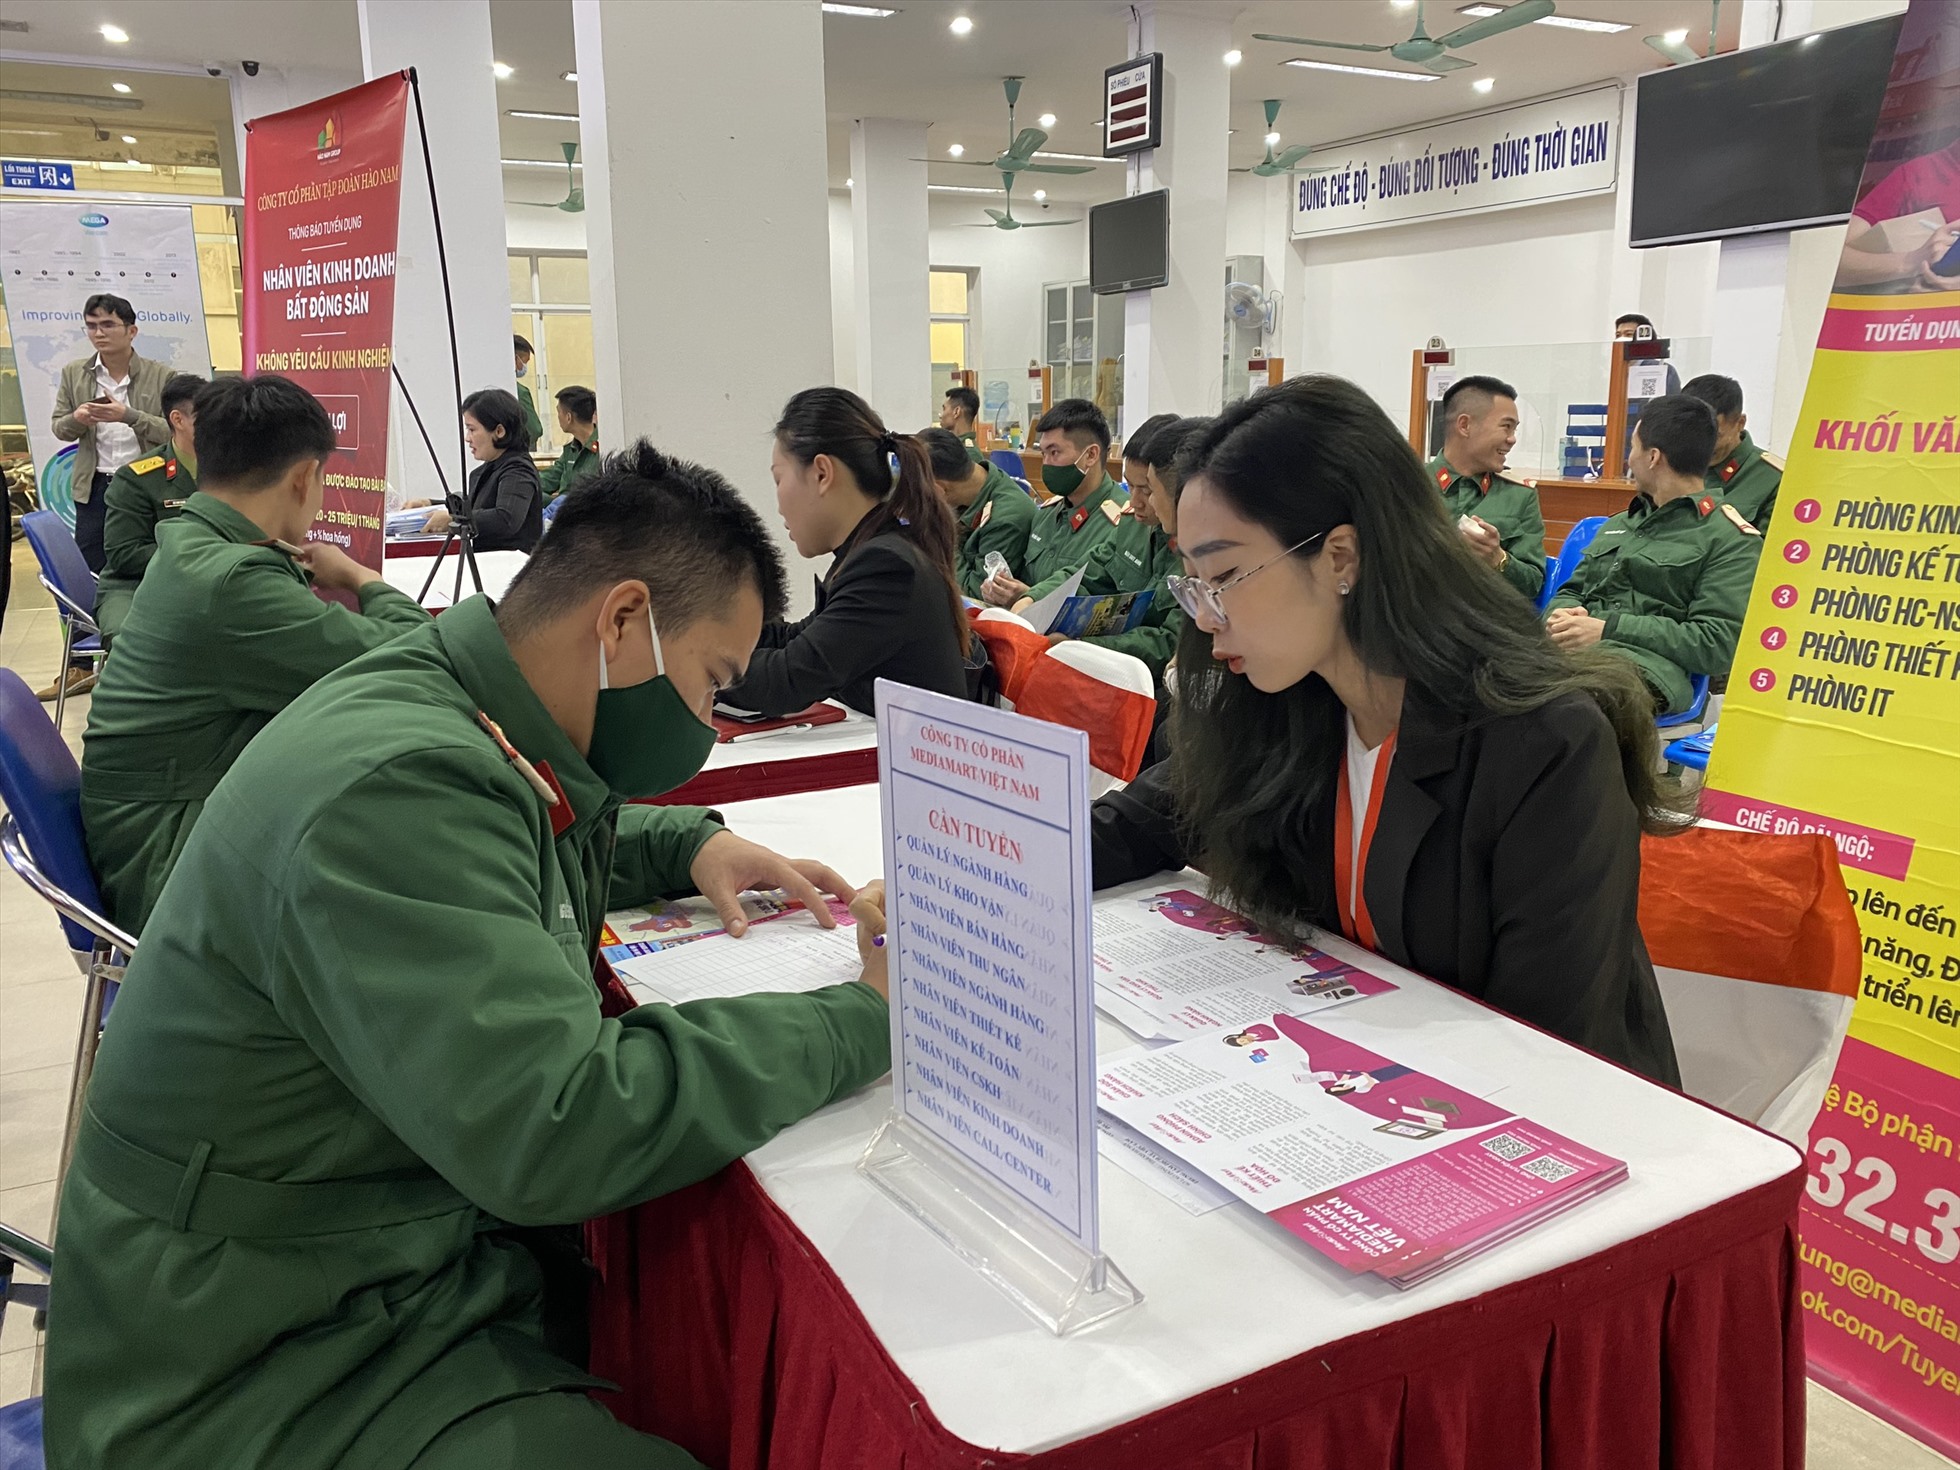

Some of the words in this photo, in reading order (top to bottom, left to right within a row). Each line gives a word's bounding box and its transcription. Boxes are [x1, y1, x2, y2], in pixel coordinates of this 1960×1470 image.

[258, 193, 277, 211] CÔNG
[277, 192, 288, 207] TY
[288, 184, 299, 205] CỔ
[300, 181, 321, 203] PHẦN
[322, 179, 337, 201] TẬP
[338, 173, 361, 195] ĐOÀN
[361, 168, 379, 189] HÀO
[380, 164, 399, 185] NAM
[1299, 173, 1327, 212] ĐÚNG
[1330, 160, 1353, 207] CHẾ
[1353, 161, 1368, 210] ĐỘ
[1379, 156, 1411, 199] ĐÚNG
[1414, 143, 1435, 193] ĐỐI
[1438, 145, 1479, 195] TƯỢNG
[1492, 132, 1530, 180] ĐÚNG
[1535, 121, 1567, 172] THỜI
[1571, 121, 1609, 166] GIAN
[82, 216, 106, 224] MEGA
[288, 226, 309, 240] THÔNG
[310, 221, 323, 236] BÁO
[344, 215, 362, 233] DỤNG
[263, 263, 293, 291] NHÂN
[295, 259, 321, 288] VIÊN
[323, 259, 352, 284] KINH
[354, 251, 395, 280] DOANH
[22, 309, 82, 323] Improvin
[137, 311, 193, 324] Globally.
[286, 290, 308, 320] BẤT
[309, 290, 342, 323] ĐỘNG
[344, 285, 369, 315] SẢN
[1864, 314, 1923, 342] TUYỂN
[256, 349, 288, 370] KHÔNG
[290, 348, 308, 370] YÊU
[309, 345, 330, 370] CẦU
[332, 350, 356, 369] KINH
[332, 411, 347, 434] LỢI
[1814, 410, 1902, 454] KHỐI
[325, 473, 345, 490] ĐƯỢC
[345, 474, 359, 490] ĐÀO
[359, 477, 371, 493] TẠO
[328, 511, 336, 523] 25
[362, 514, 381, 530] THÁNG
[1803, 504, 1813, 518] 1
[1833, 496, 1916, 532] PHÒNG
[322, 530, 334, 542] hoa
[334, 531, 351, 547] hồng)
[1790, 544, 1803, 559] 2
[1821, 541, 1904, 578] PHÒNG
[1905, 543, 1949, 582] KẾ
[1779, 589, 1790, 604] 3
[1810, 585, 1892, 624] PHÒNG
[1767, 631, 1779, 646] 4
[1798, 629, 1880, 669] PHÒNG
[1883, 640, 1951, 679] THIẾT
[1756, 673, 1768, 688] 5
[1787, 673, 1868, 714] PHÒNG
[1868, 687, 1895, 718] IT
[920, 724, 952, 748] CÔNG
[953, 735, 969, 753] TY
[972, 739, 988, 759] CỔ
[991, 746, 1025, 770] PHẦN
[911, 746, 978, 780] MEDIAMART
[980, 769, 1008, 791] VIỆT
[1010, 778, 1040, 801] NAM
[929, 807, 961, 839] CẦN
[963, 822, 1023, 864] TUYỂN
[1735, 808, 1777, 832] CHẾ
[1834, 834, 1875, 862] NGỘ:
[907, 834, 935, 857] QUẢN
[937, 846, 951, 863] LÝ
[953, 853, 992, 882] NGÀNH
[994, 870, 1028, 898] HÀNG
[908, 863, 936, 886] QUẢN
[938, 876, 952, 894] LÝ
[954, 884, 978, 906] KHO
[980, 896, 1004, 918] VẬN
[1862, 888, 1901, 921] lên
[1905, 904, 1957, 938] đến
[909, 891, 938, 917] NHÂN
[939, 906, 964, 930] VIÊN
[966, 919, 989, 942] BÁN
[991, 931, 1025, 960] HÀNG
[910, 920, 938, 946] NHÂN
[940, 935, 965, 960] VIÊN
[967, 949, 990, 973] THU
[992, 963, 1025, 991] NGÂN
[1863, 936, 1935, 978] năng,
[912, 949, 940, 976] NHÂN
[941, 965, 966, 989] VIÊN
[968, 980, 1008, 1015] NGÀNH
[1010, 1003, 1045, 1034] HÀNG
[1863, 974, 1924, 1015] triển
[913, 977, 940, 1004] NHÂN
[942, 994, 967, 1019] VIÊN
[969, 1010, 1002, 1040] THIẾT
[1005, 1031, 1022, 1052] KẾ
[914, 1006, 941, 1032] NHÂN
[943, 1023, 968, 1050] VIÊN
[971, 1040, 986, 1063] KẾ
[987, 1051, 1021, 1081] TOÁN
[914, 1034, 943, 1062] NHÂN
[945, 1053, 969, 1080] VIÊN
[971, 1071, 1001, 1100] CSKH
[916, 1062, 944, 1089] NHÂN
[946, 1081, 970, 1108] VIÊN
[972, 1100, 1001, 1130] KINH
[1002, 1119, 1045, 1158] DOANH
[1843, 1090, 1879, 1129] Bộ
[1880, 1112, 1953, 1158] phận
[917, 1090, 945, 1119] NHÂN
[947, 1110, 972, 1138] VIÊN
[1004, 1151, 1052, 1194] CENTER
[1312, 1203, 1393, 1254] MEDIAMART
[1326, 1196, 1371, 1224] NAM
[1340, 1232, 1354, 1241] TY
[1352, 1239, 1380, 1258] CÔNG
[1364, 1223, 1407, 1248] VIỆT
[1798, 1233, 1960, 1346] ung@media
